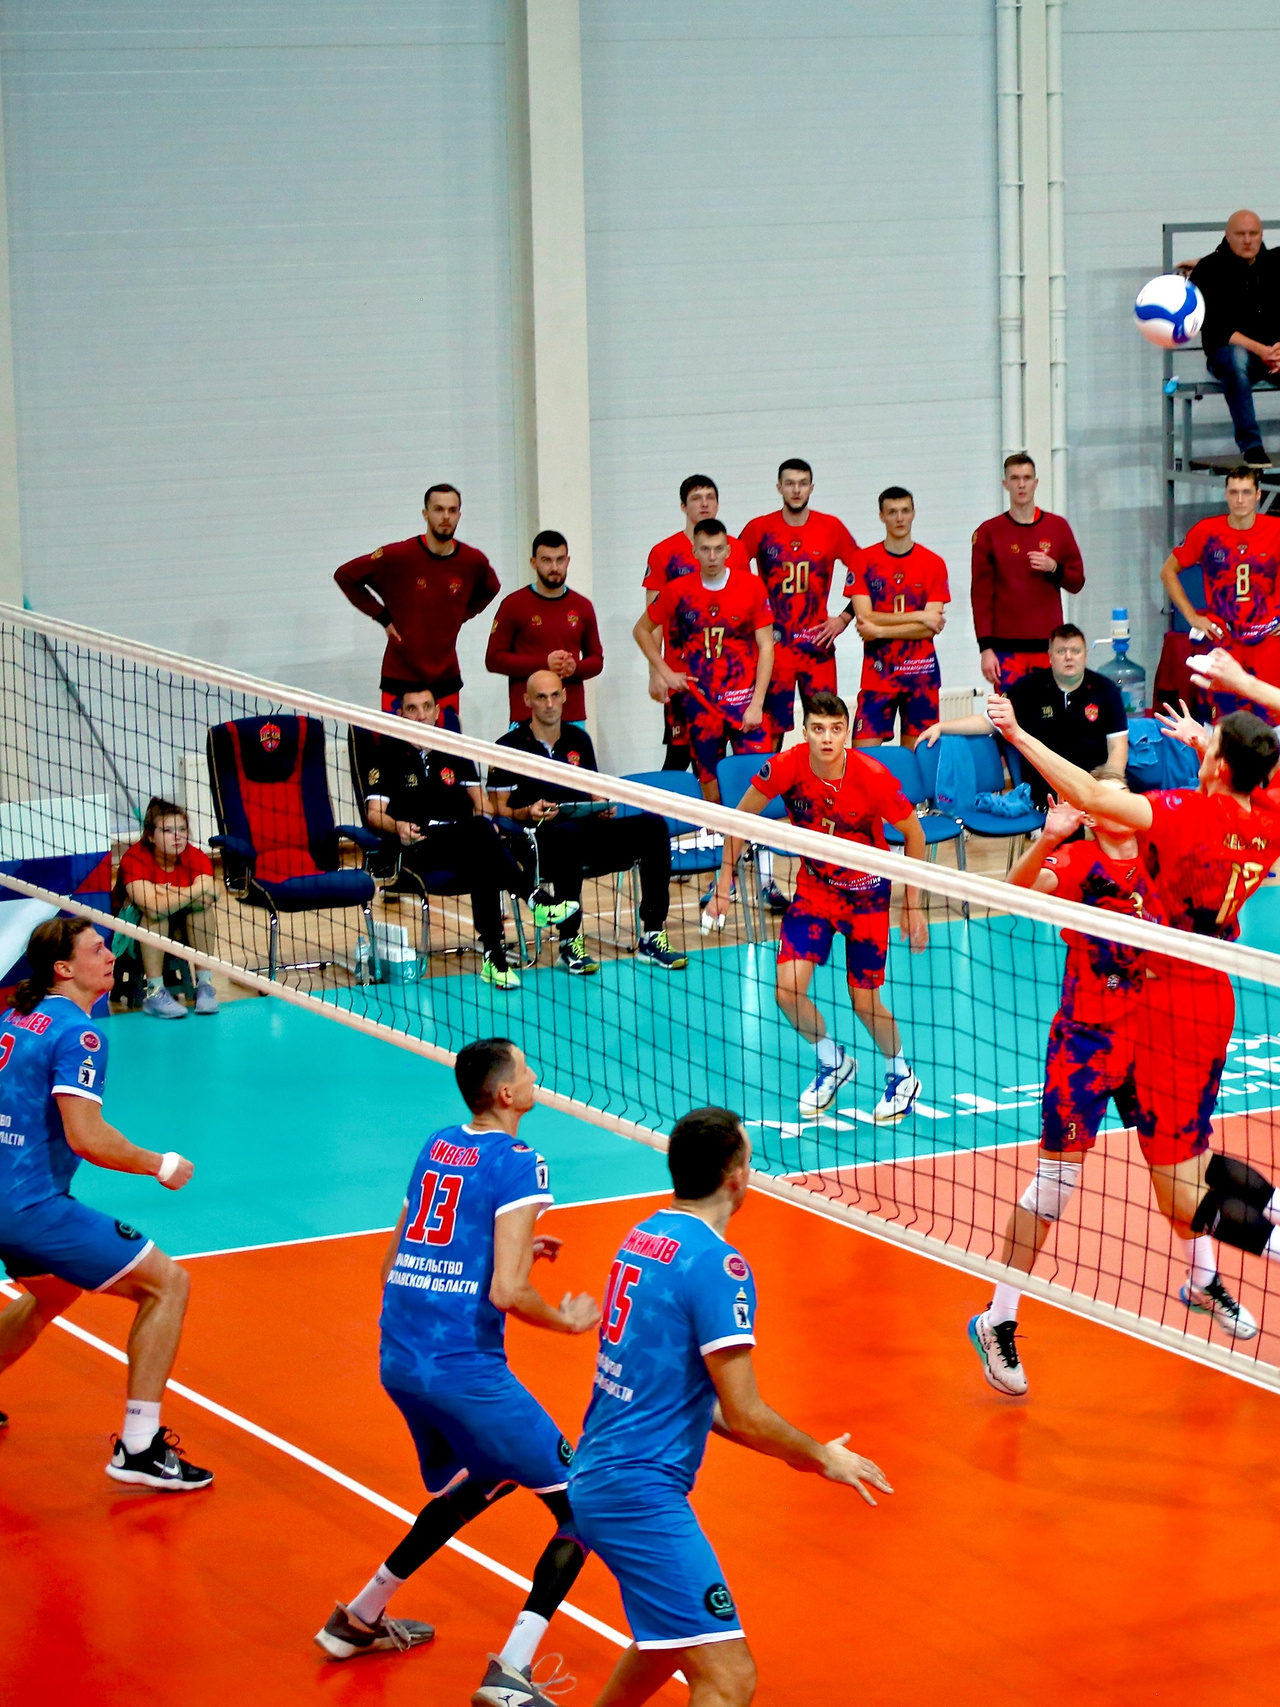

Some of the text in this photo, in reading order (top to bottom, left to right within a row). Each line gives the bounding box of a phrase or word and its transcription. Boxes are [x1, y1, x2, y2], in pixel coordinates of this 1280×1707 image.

[782, 561, 809, 594] 20
[1236, 564, 1250, 595] 8
[703, 627, 725, 659] 17
[1067, 1122, 1077, 1140] 3
[405, 1169, 464, 1247] 13
[431, 1280, 479, 1295] ОБЛАСТИ
[600, 1258, 643, 1346] 15
